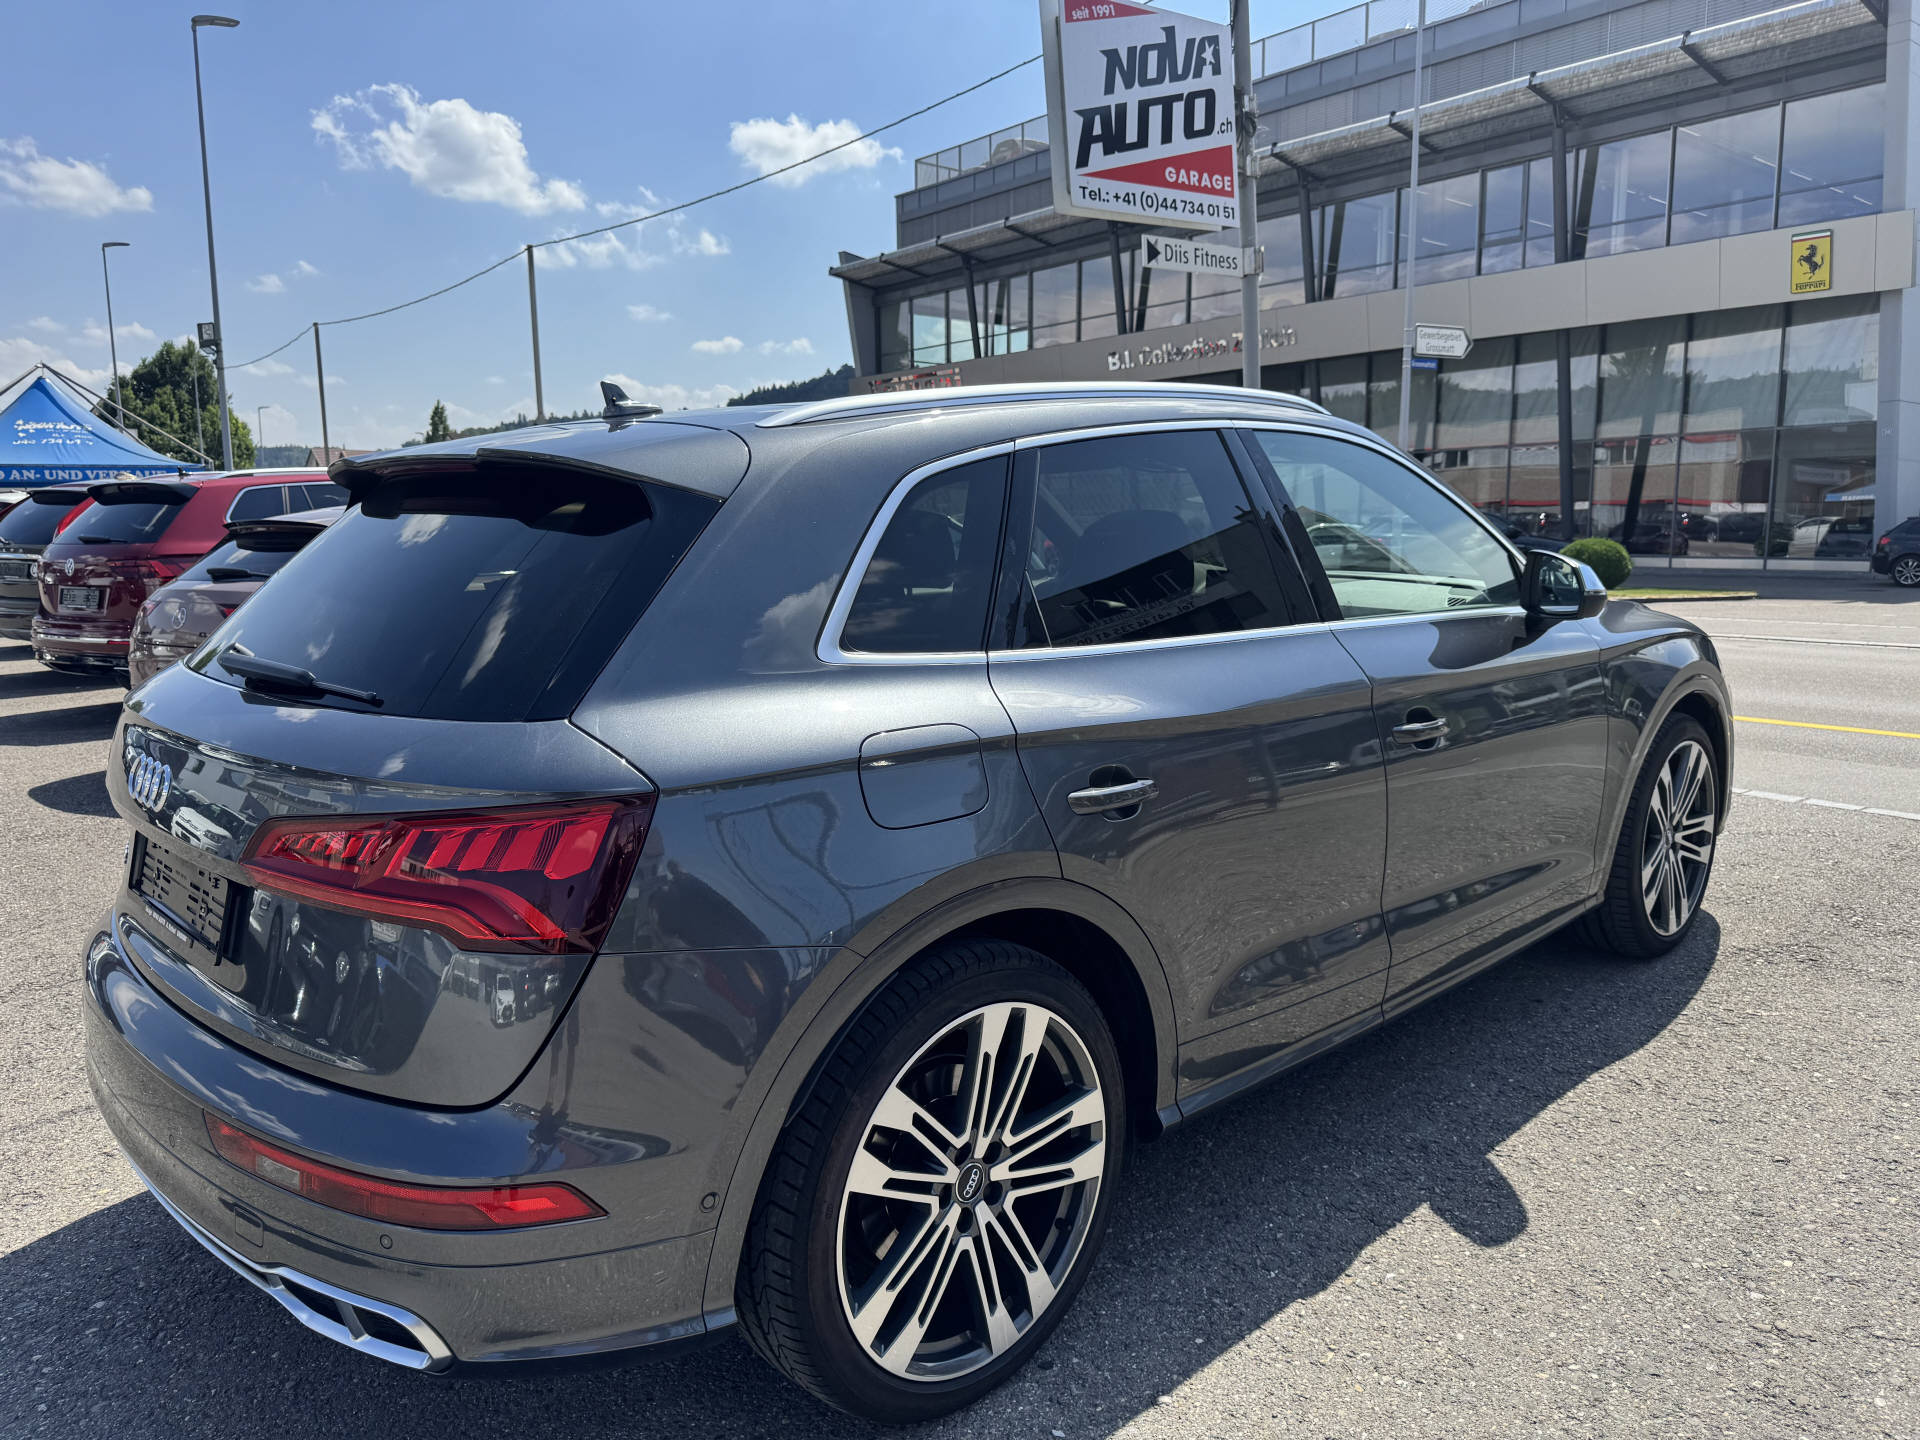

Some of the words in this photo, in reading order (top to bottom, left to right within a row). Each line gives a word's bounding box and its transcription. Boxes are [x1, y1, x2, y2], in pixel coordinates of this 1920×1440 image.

[1071, 6, 1090, 20] seit
[1092, 4, 1115, 18] 1991
[1099, 25, 1222, 96] NOVA
[1164, 166, 1232, 192] GARAGE
[1079, 185, 1110, 203] Tel.:
[1113, 190, 1136, 208] +41
[1180, 200, 1205, 216] 734
[1208, 202, 1221, 218] 01
[1223, 205, 1235, 220] 51
[1164, 243, 1189, 265] Diis
[1194, 247, 1239, 270] Fitness
[1795, 280, 1826, 291] Ferrari
[1107, 350, 1135, 371] B.I.
[1138, 337, 1228, 366] Collection
[1231, 328, 1297, 353] Zich
[9, 470, 41, 481] AN-
[44, 470, 83, 481] UND
